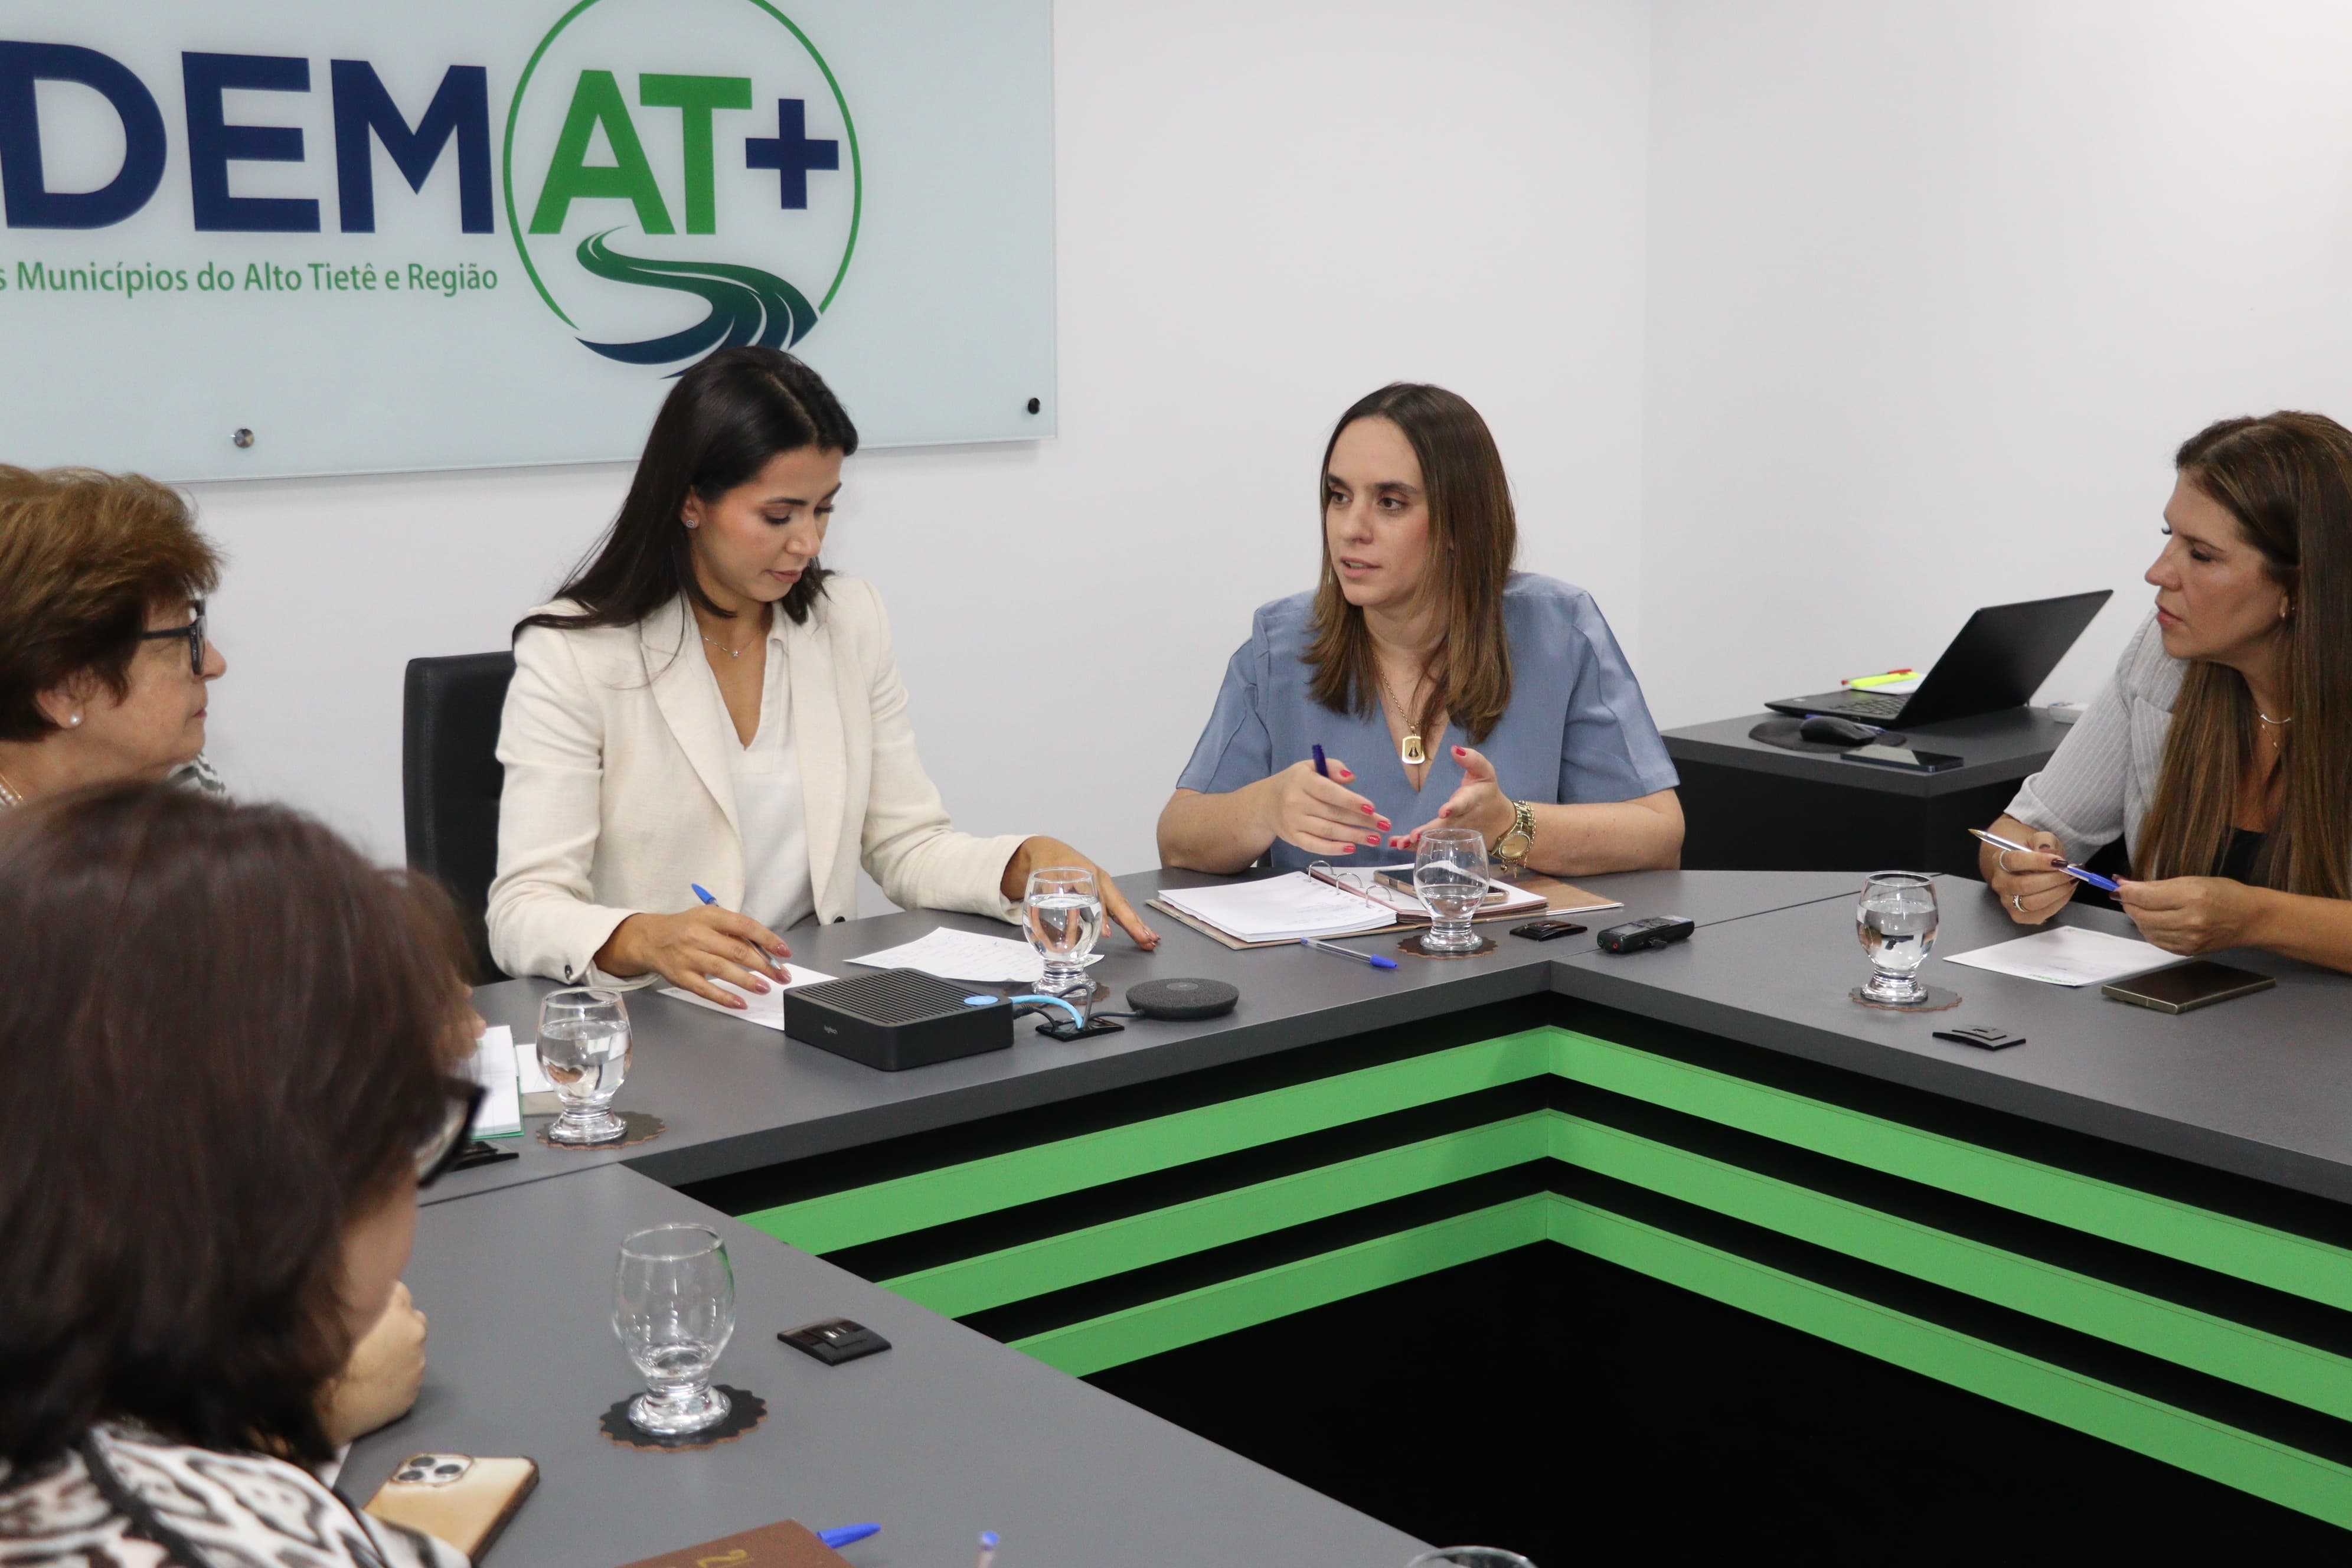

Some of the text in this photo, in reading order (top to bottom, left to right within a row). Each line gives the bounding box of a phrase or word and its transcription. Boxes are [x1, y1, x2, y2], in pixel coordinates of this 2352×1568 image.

[17, 261, 188, 298] Municípios
[197, 263, 235, 291] do
[244, 263, 303, 291] Alto
[308, 263, 377, 291] Tietê
[385, 271, 400, 290] e
[408, 263, 498, 298] Região
